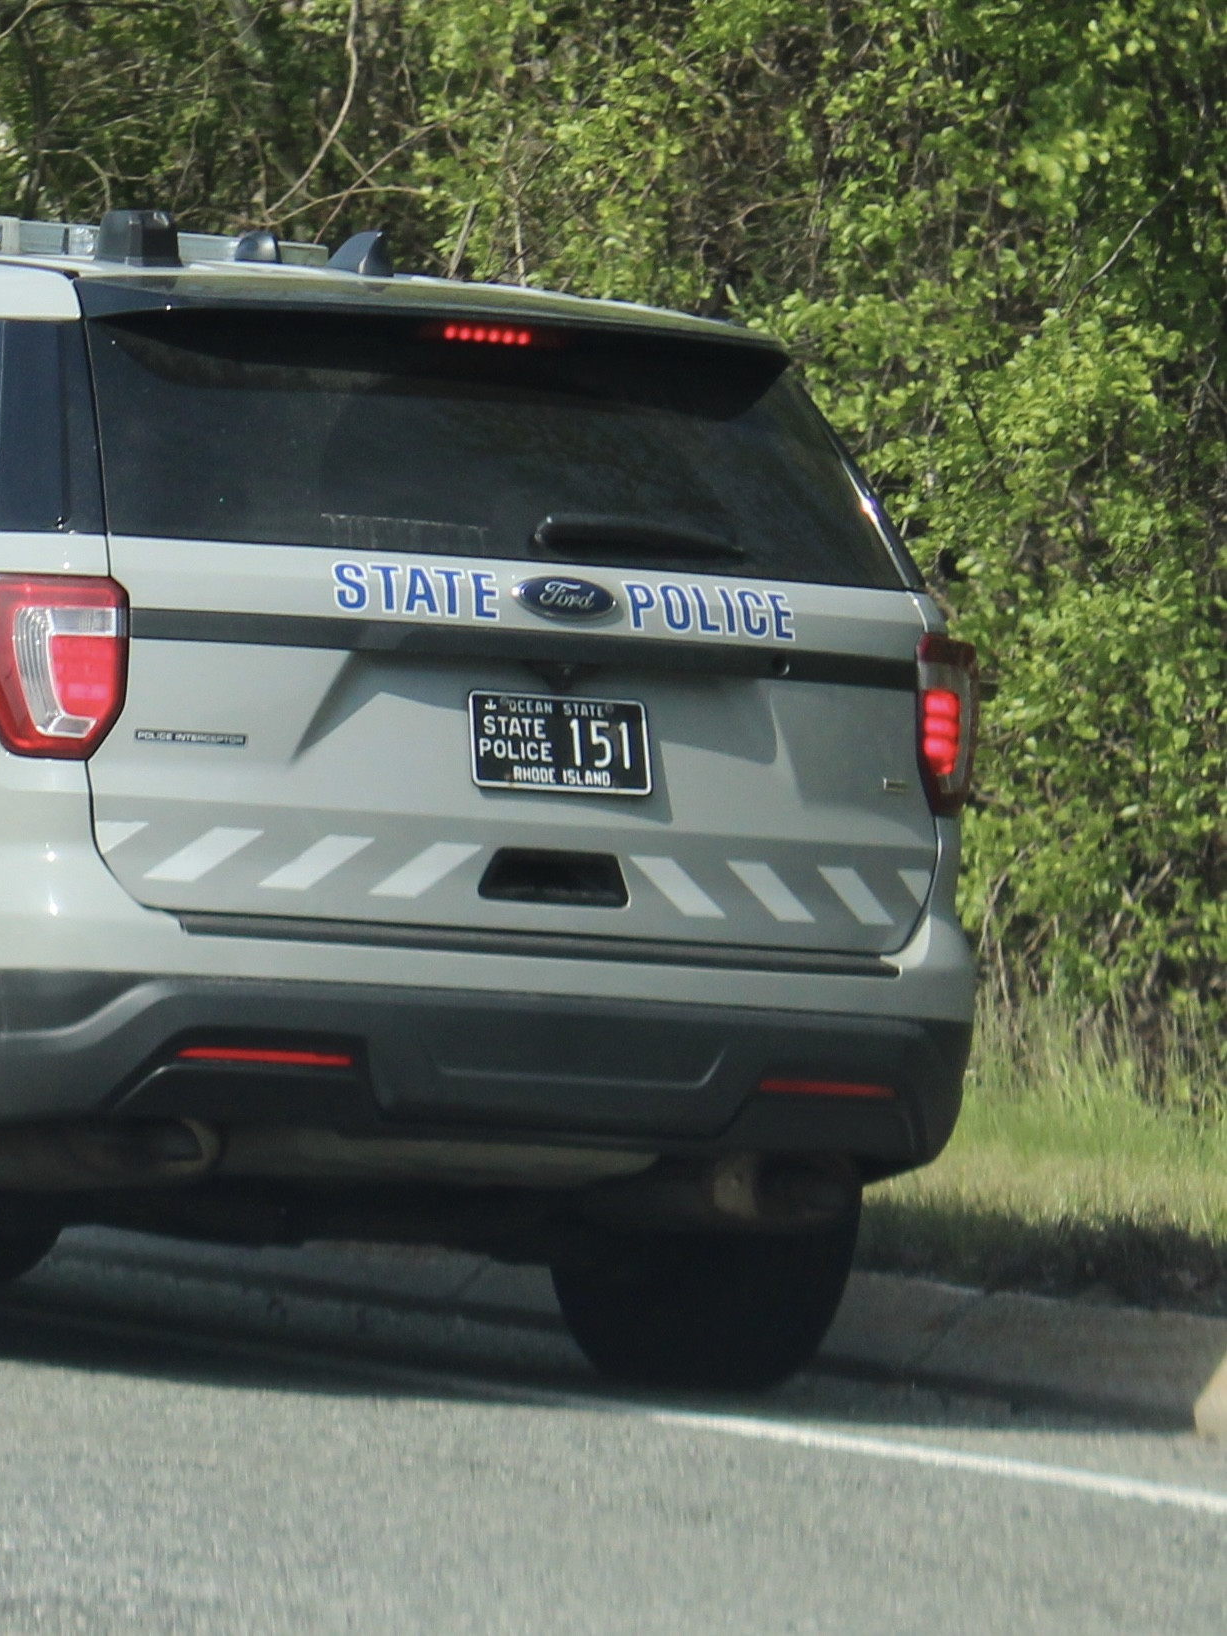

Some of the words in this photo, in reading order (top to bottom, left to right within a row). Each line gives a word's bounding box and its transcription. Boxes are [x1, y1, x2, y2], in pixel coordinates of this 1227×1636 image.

[333, 561, 499, 620] STATE
[622, 581, 795, 641] POLICE
[539, 581, 595, 609] Ford
[509, 700, 553, 714] OCEAN
[563, 703, 605, 718] STATE
[137, 731, 173, 741] POLICE
[483, 715, 546, 739] STATE
[479, 737, 553, 762] POLICE
[569, 718, 631, 770] 151
[513, 766, 556, 784] RHODE
[562, 769, 611, 787] ISLAND
